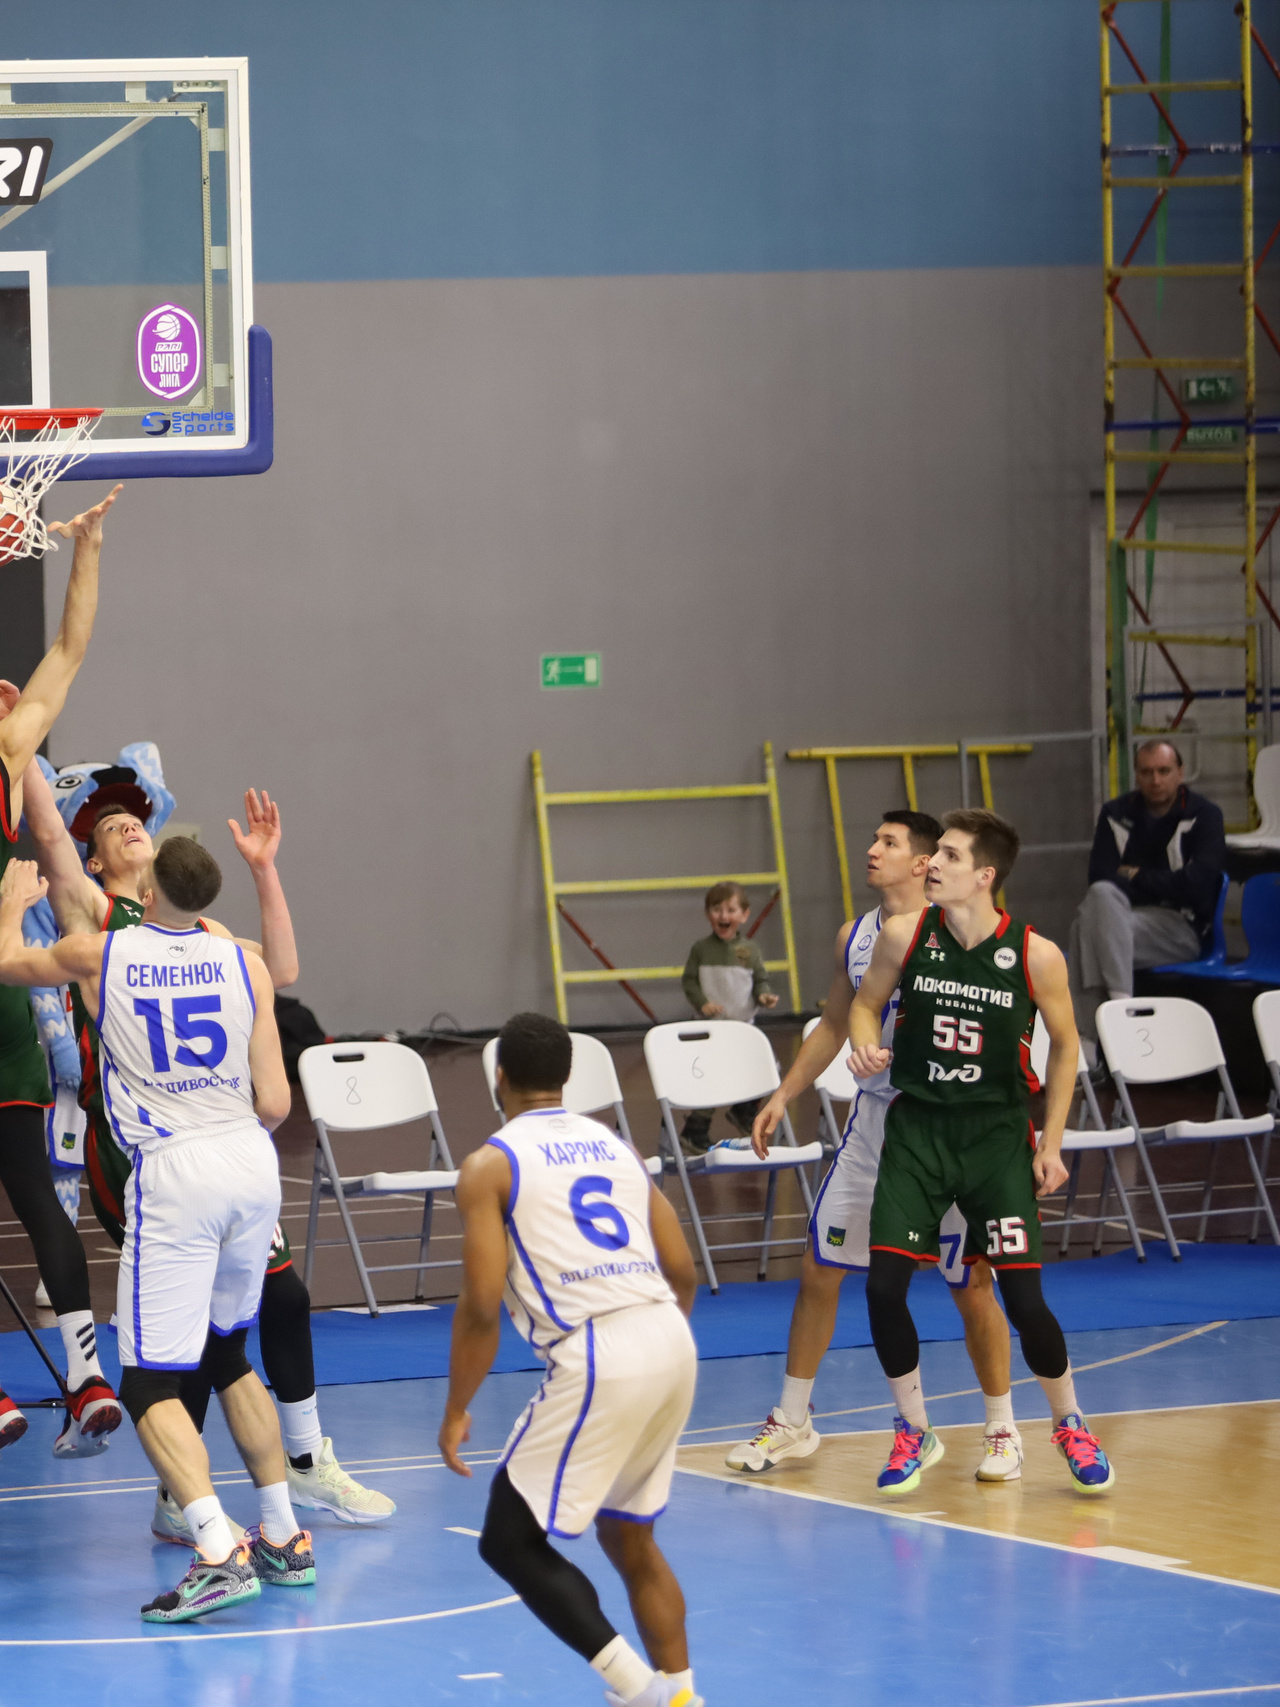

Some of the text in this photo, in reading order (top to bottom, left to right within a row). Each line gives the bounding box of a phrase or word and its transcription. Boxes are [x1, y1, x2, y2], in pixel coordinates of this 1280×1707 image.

[159, 374, 180, 387] ЛИГА
[172, 411, 234, 422] Schelde
[172, 422, 234, 435] Sports
[126, 961, 226, 988] СЕМЕНЮК
[913, 975, 1013, 1009] ЛОКОМОТИВ
[936, 997, 984, 1014] КУБАНЬ
[133, 994, 228, 1073] 15
[932, 1014, 983, 1055] 55
[1136, 1028, 1154, 1058] 3
[692, 1056, 705, 1079] 6
[345, 1076, 362, 1105] 8
[537, 1139, 616, 1167] ХАРРИС
[568, 1174, 630, 1252] 6
[986, 1216, 1029, 1257] 55
